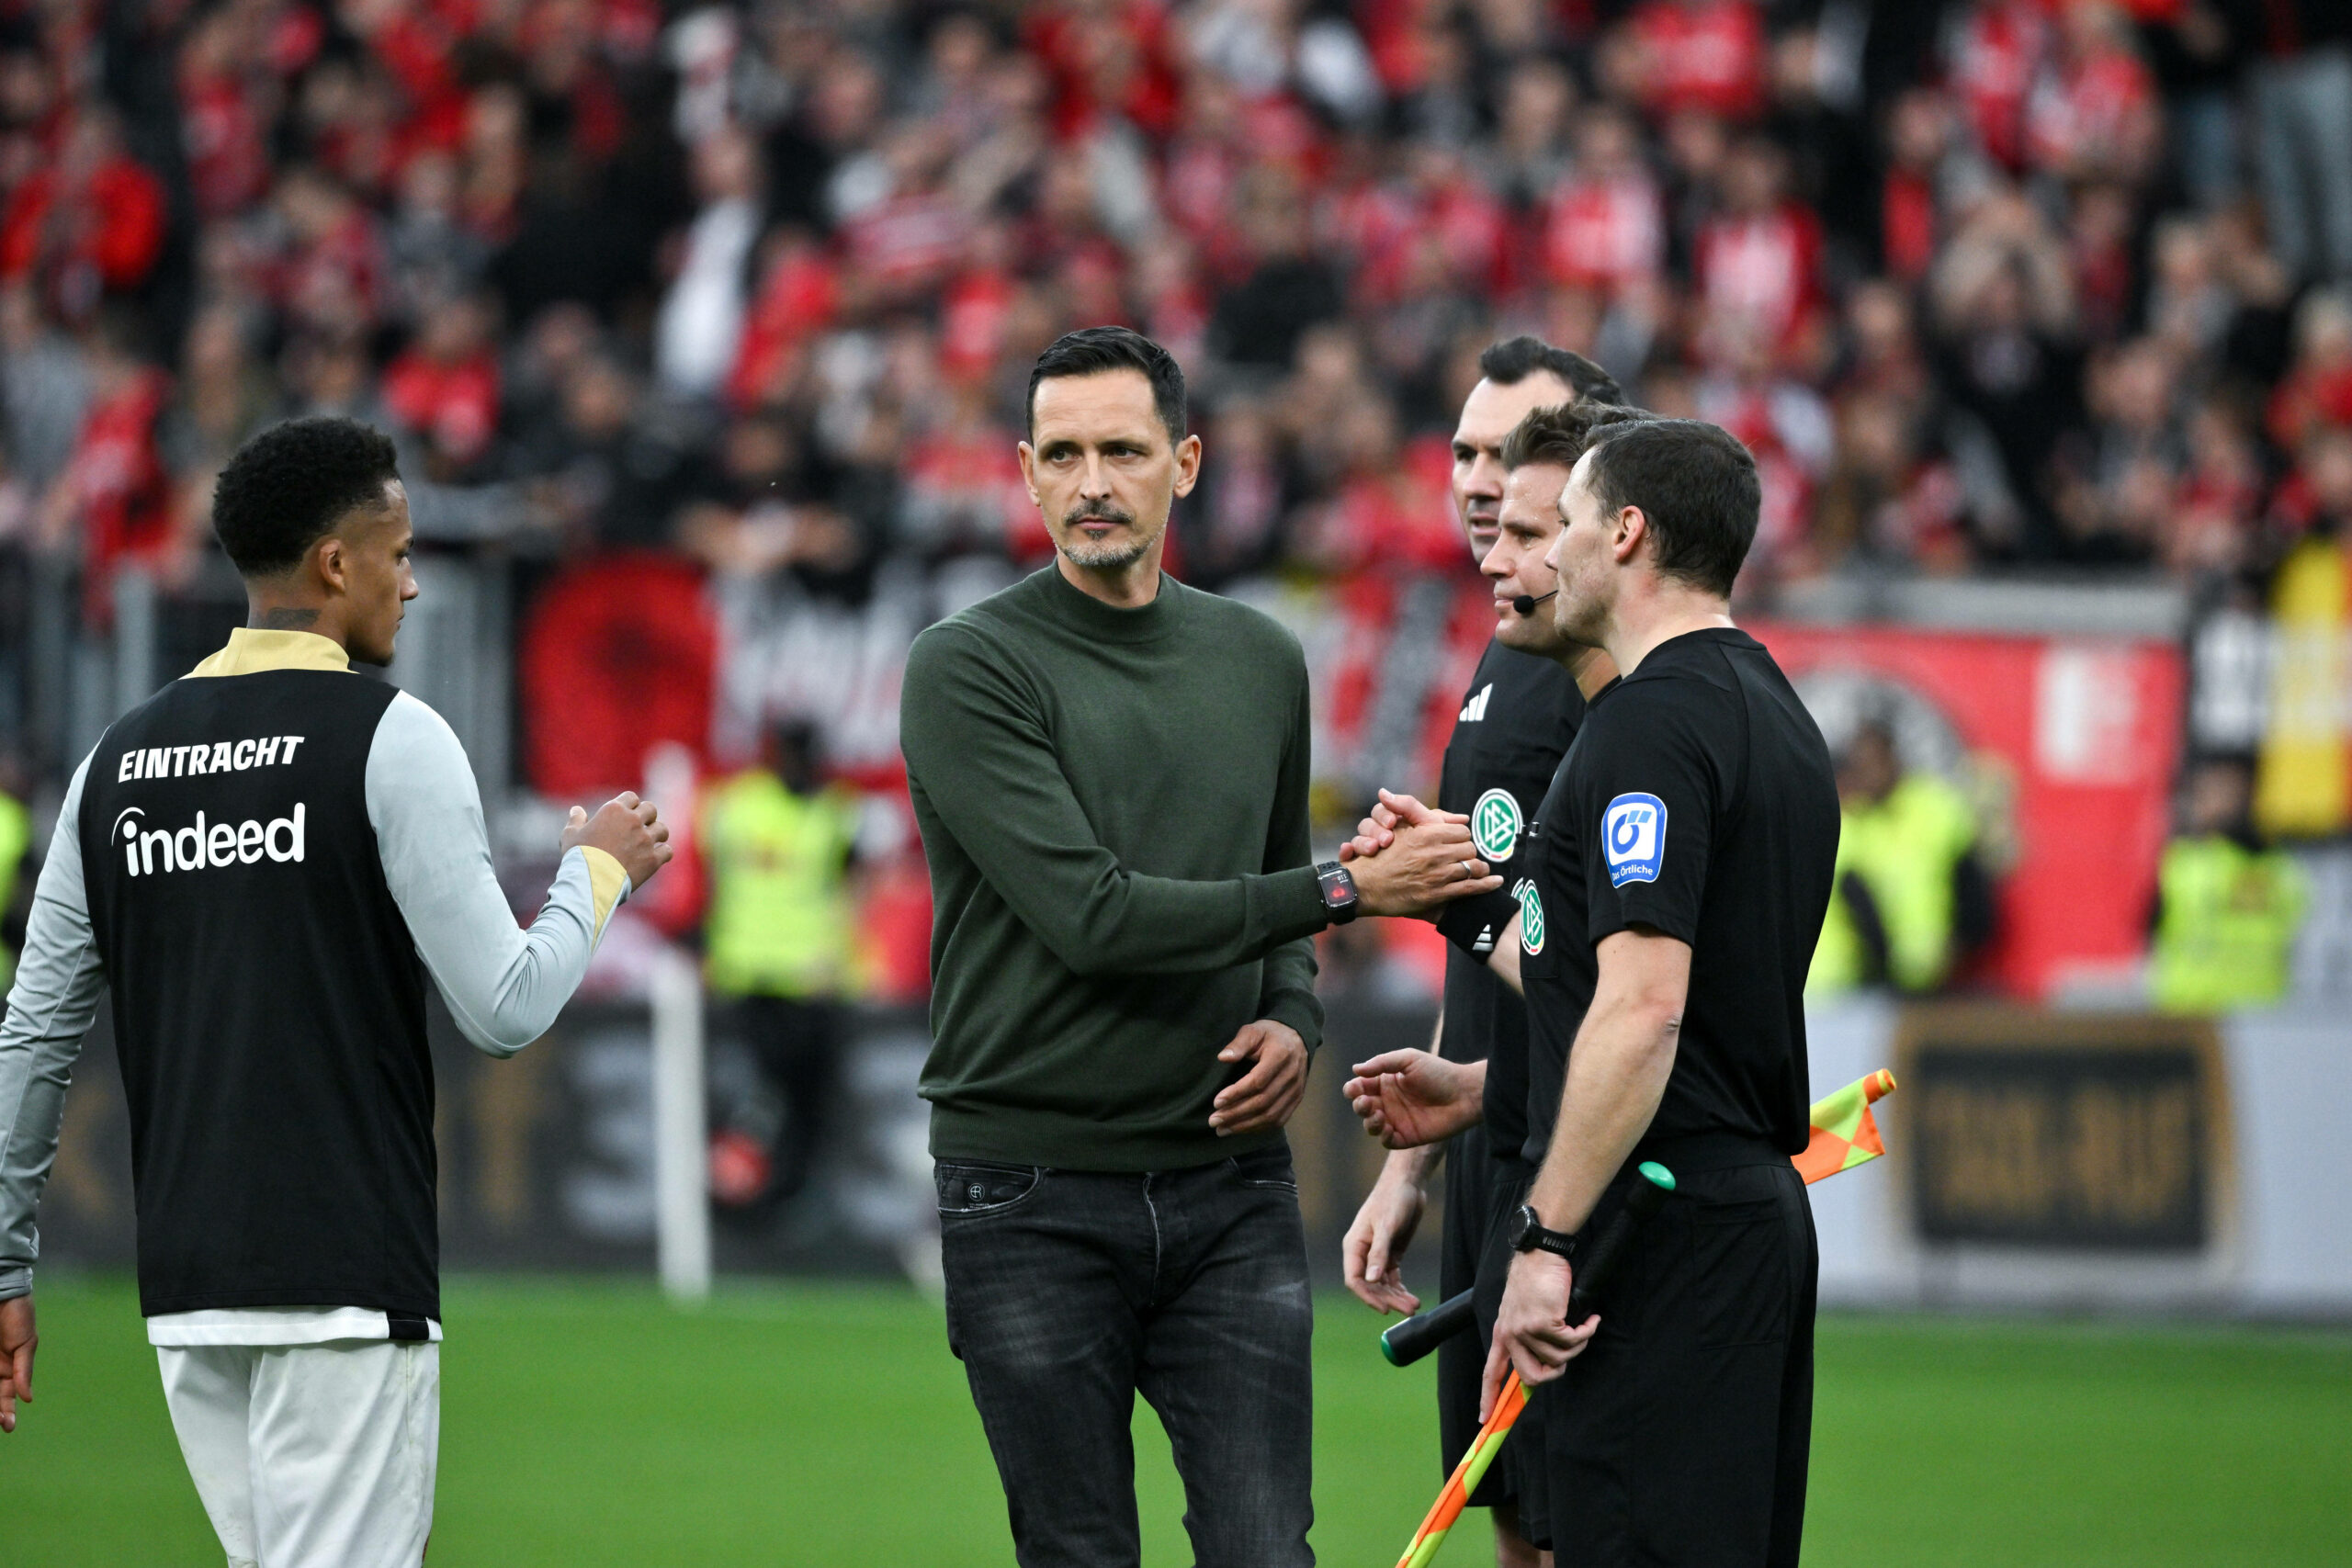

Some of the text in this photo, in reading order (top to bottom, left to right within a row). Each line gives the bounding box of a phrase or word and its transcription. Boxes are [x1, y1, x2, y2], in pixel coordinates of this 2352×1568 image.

[118, 735, 305, 784] EINTRACHT
[122, 802, 306, 877] indeed
[1620, 863, 1654, 876] Örtliche
